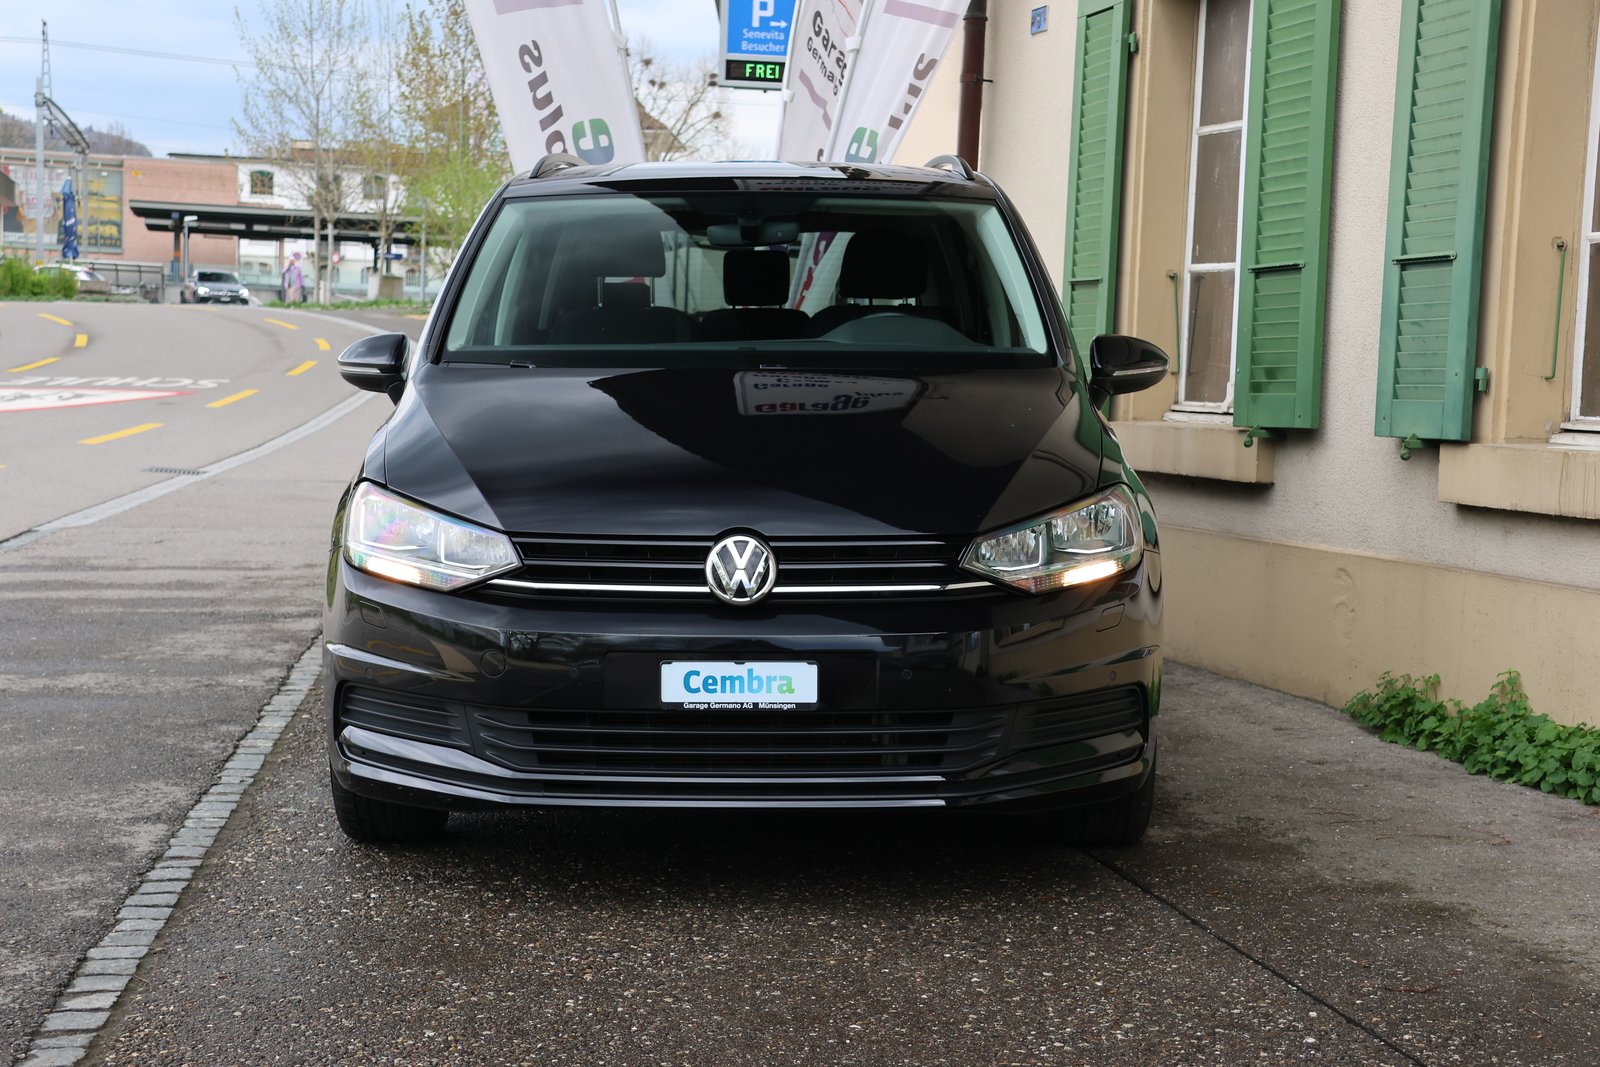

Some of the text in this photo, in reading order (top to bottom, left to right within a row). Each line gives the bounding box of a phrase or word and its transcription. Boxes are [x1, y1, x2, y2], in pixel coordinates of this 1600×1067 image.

[752, 0, 775, 27] P
[742, 28, 785, 40] Senevita
[741, 41, 785, 52] Besucher
[745, 63, 780, 79] FREI
[807, 36, 838, 96] Germao
[683, 668, 795, 695] Cembra
[683, 702, 708, 710] Garage
[758, 702, 796, 710] Münsingen
